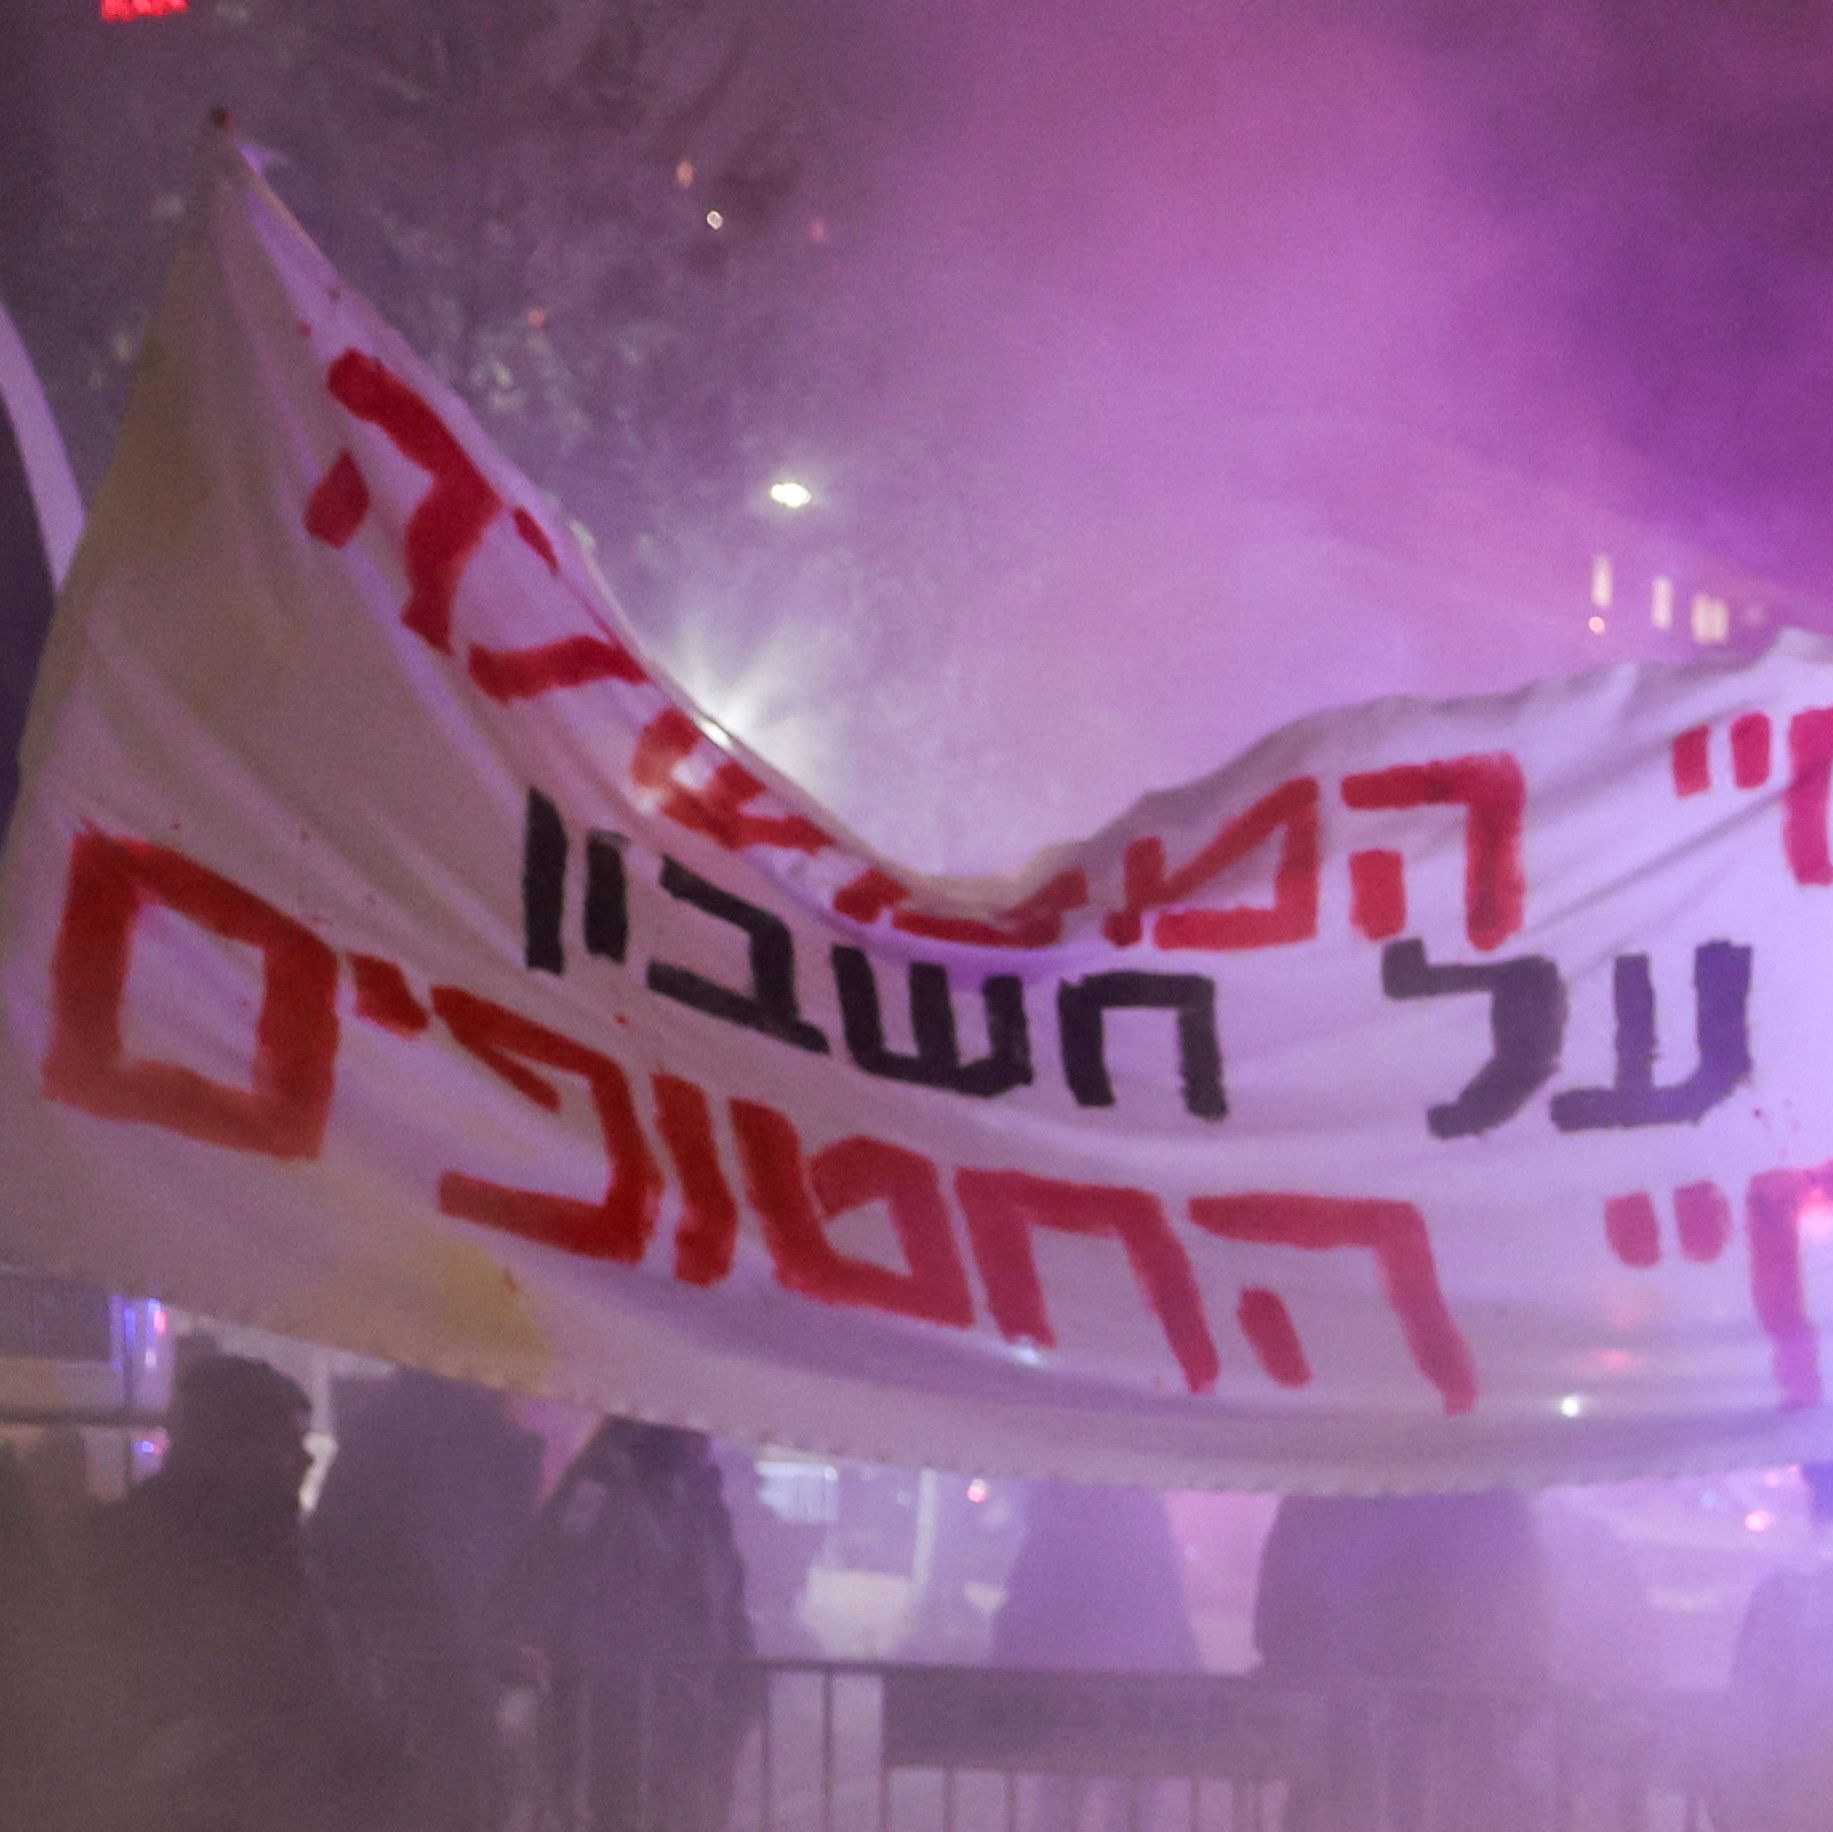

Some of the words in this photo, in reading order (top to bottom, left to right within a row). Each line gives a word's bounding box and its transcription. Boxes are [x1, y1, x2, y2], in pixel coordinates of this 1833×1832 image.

[522, 787, 1228, 1120] חשבון
[1382, 938, 1755, 1140] על
[44, 832, 1476, 1415] החטופים
